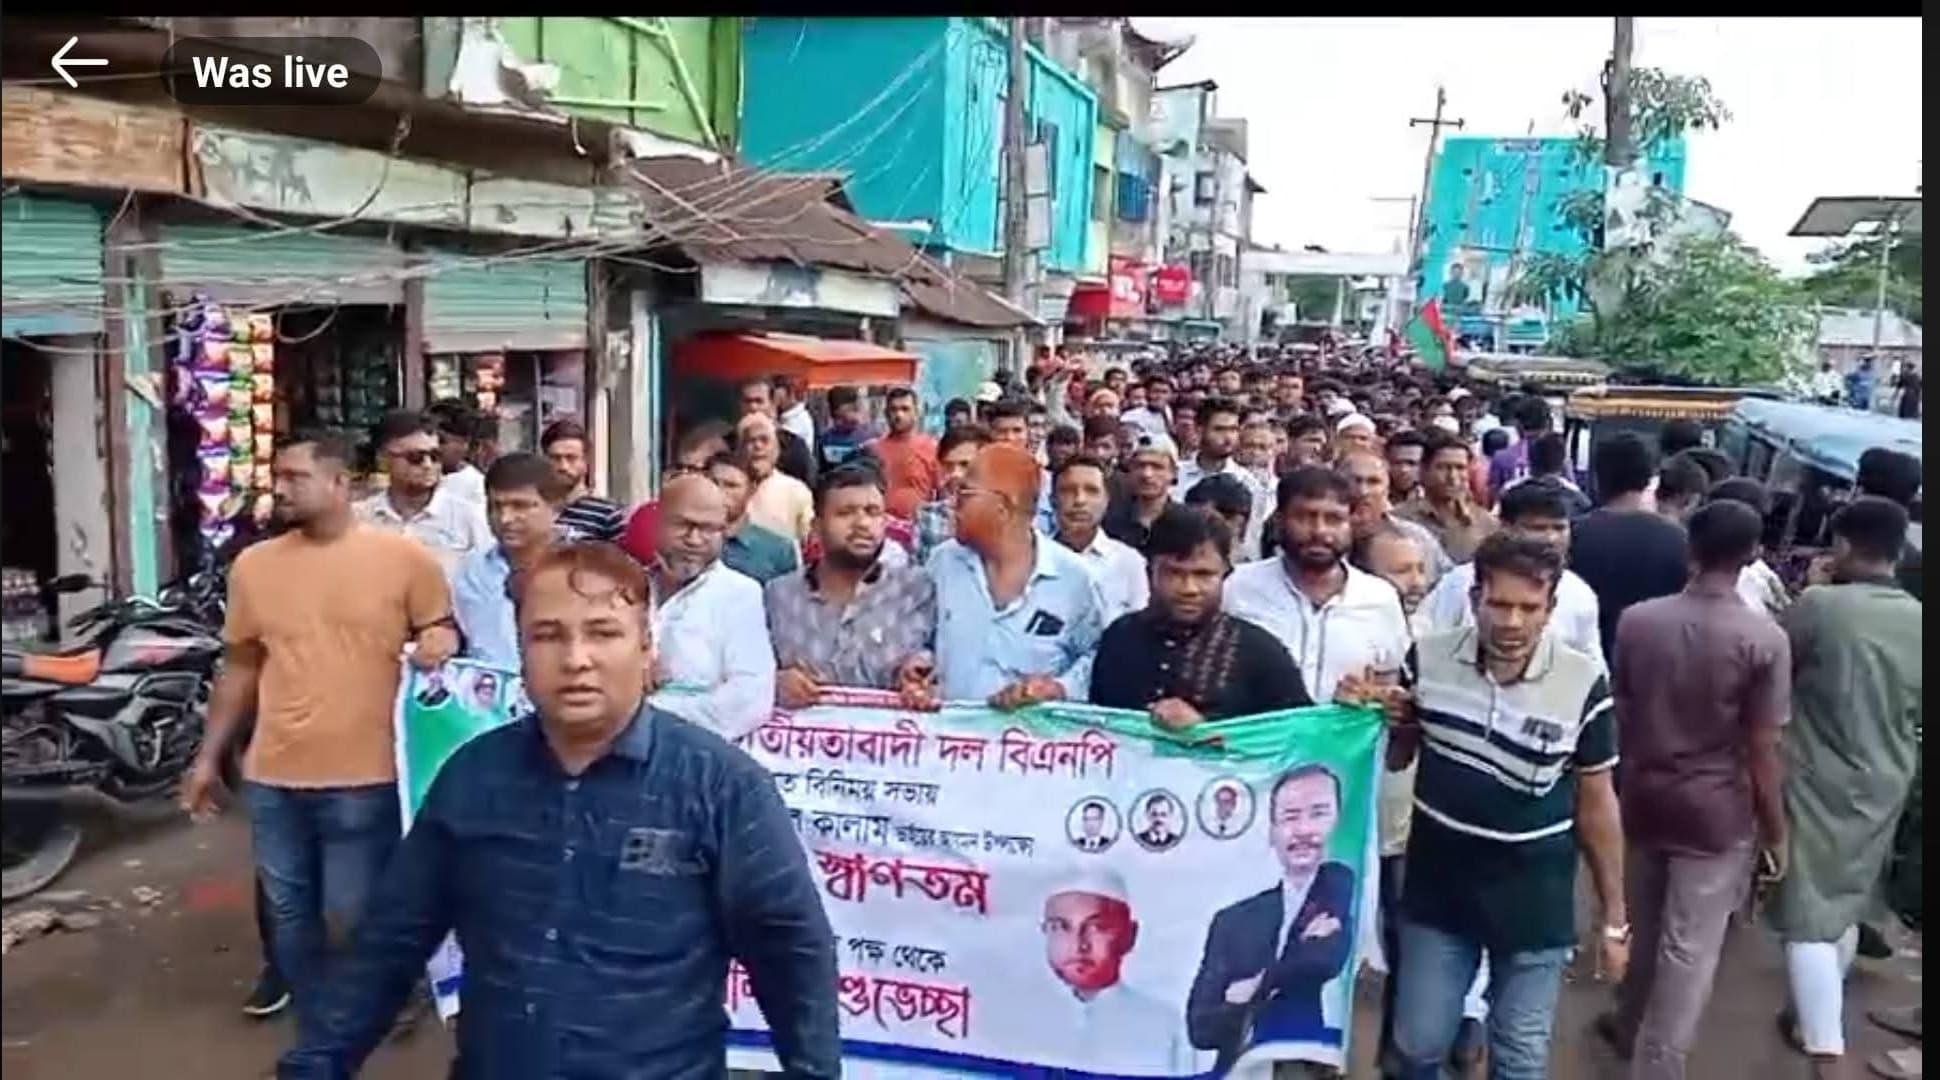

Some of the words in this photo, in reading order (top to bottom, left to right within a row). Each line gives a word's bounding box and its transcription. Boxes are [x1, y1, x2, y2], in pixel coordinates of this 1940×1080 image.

[938, 734, 988, 771] দল
[998, 727, 1118, 778] বিএনপি
[883, 781, 941, 806] সভায়
[812, 810, 891, 845] কালাম
[847, 938, 887, 963] পক্ষ
[893, 945, 947, 974] থেকে
